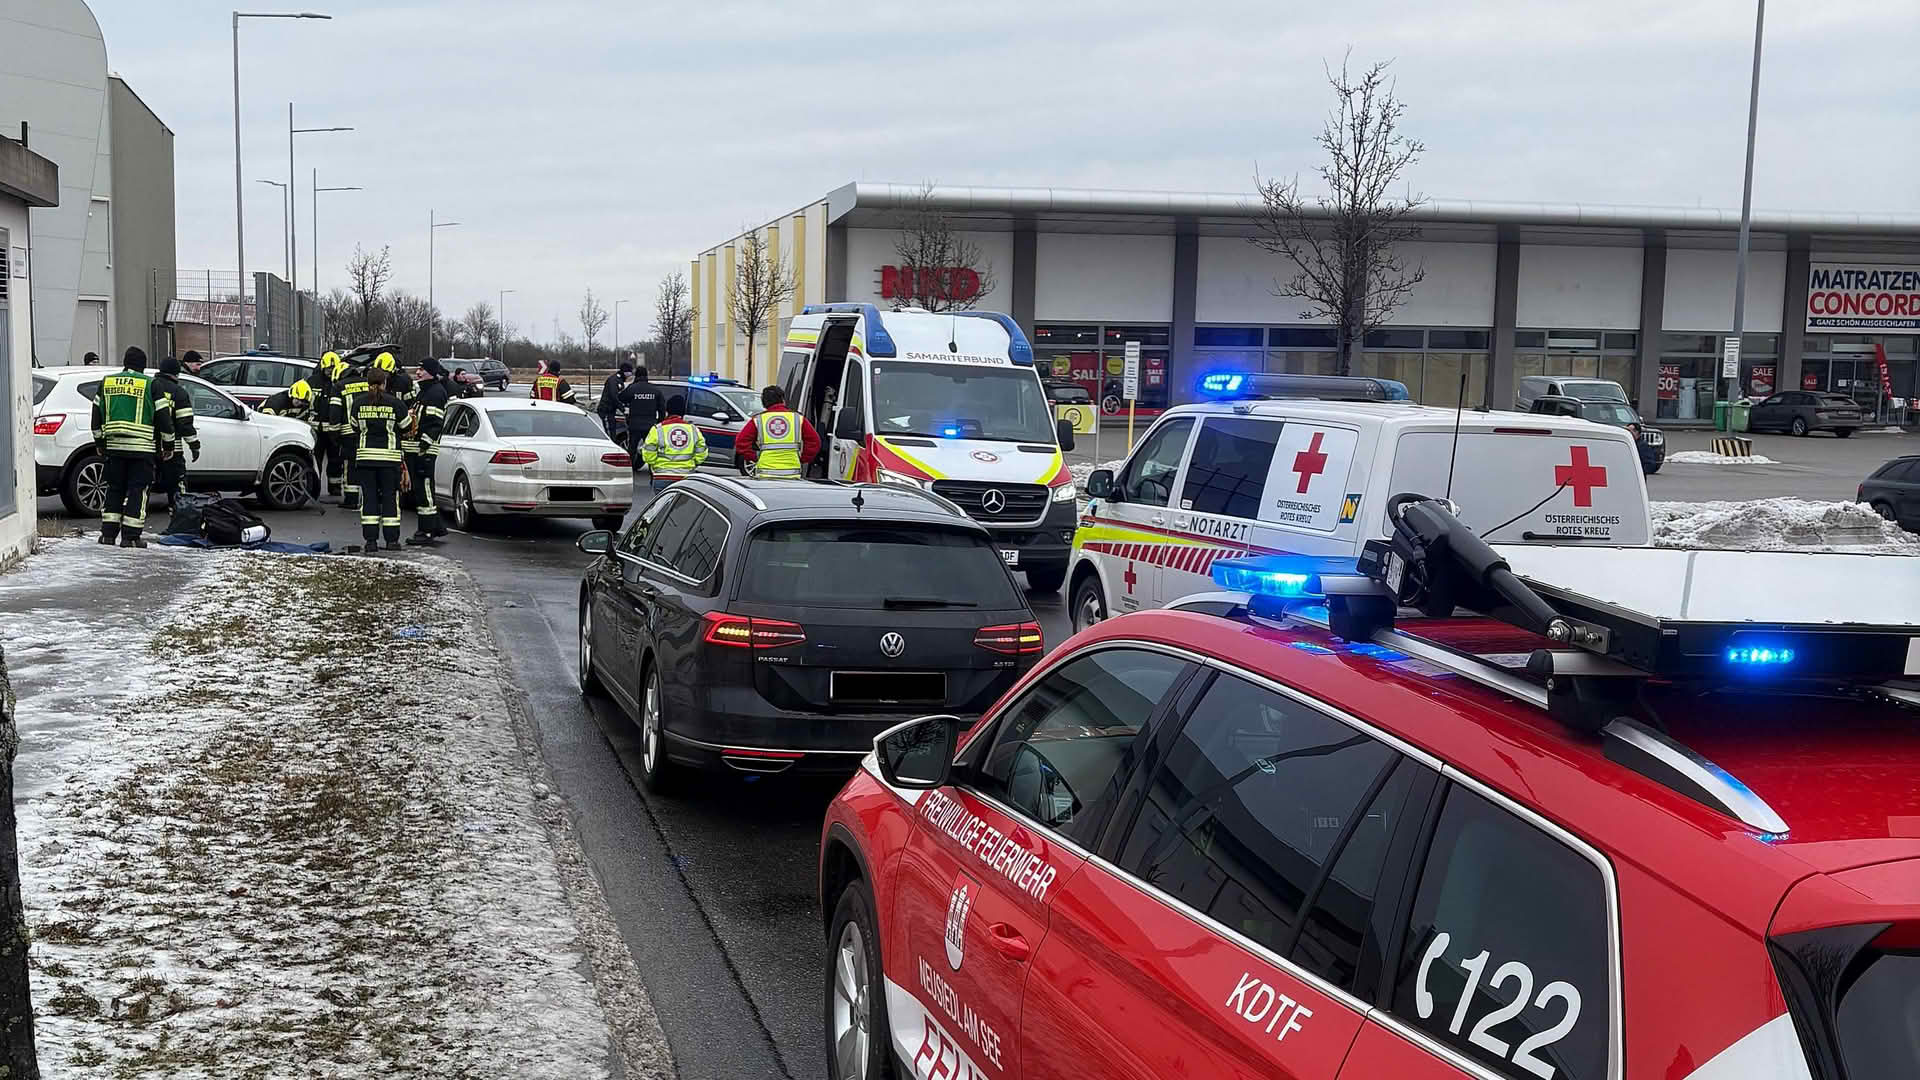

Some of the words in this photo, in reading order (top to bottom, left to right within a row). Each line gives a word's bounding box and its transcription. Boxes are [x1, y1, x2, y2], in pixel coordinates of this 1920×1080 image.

[881, 265, 980, 301] NKD
[1836, 319, 1860, 327] SCHÖN
[1861, 319, 1916, 327] AUSGESCHLAFEN
[905, 352, 1004, 365] SAMARITERBUND
[1071, 369, 1104, 381] SALE
[1658, 366, 1680, 375] SALE
[1752, 367, 1774, 376] SALE
[1279, 511, 1296, 522] ROTES
[1296, 513, 1313, 525] KREUZ
[1545, 514, 1620, 525] ÖSTERREICHISCHES
[1189, 516, 1248, 541] NOTARZT
[1556, 526, 1583, 535] ROTES
[1584, 526, 1610, 536] KREUZ
[919, 788, 987, 851] FREIWILLIGE
[974, 826, 1057, 902] FEUERWEHR
[1225, 972, 1313, 1041] KDTF
[918, 955, 964, 1031] NEUSIEDL
[963, 1002, 980, 1048] AM
[980, 1019, 1004, 1072] SEE
[1449, 950, 1582, 1080] 122
